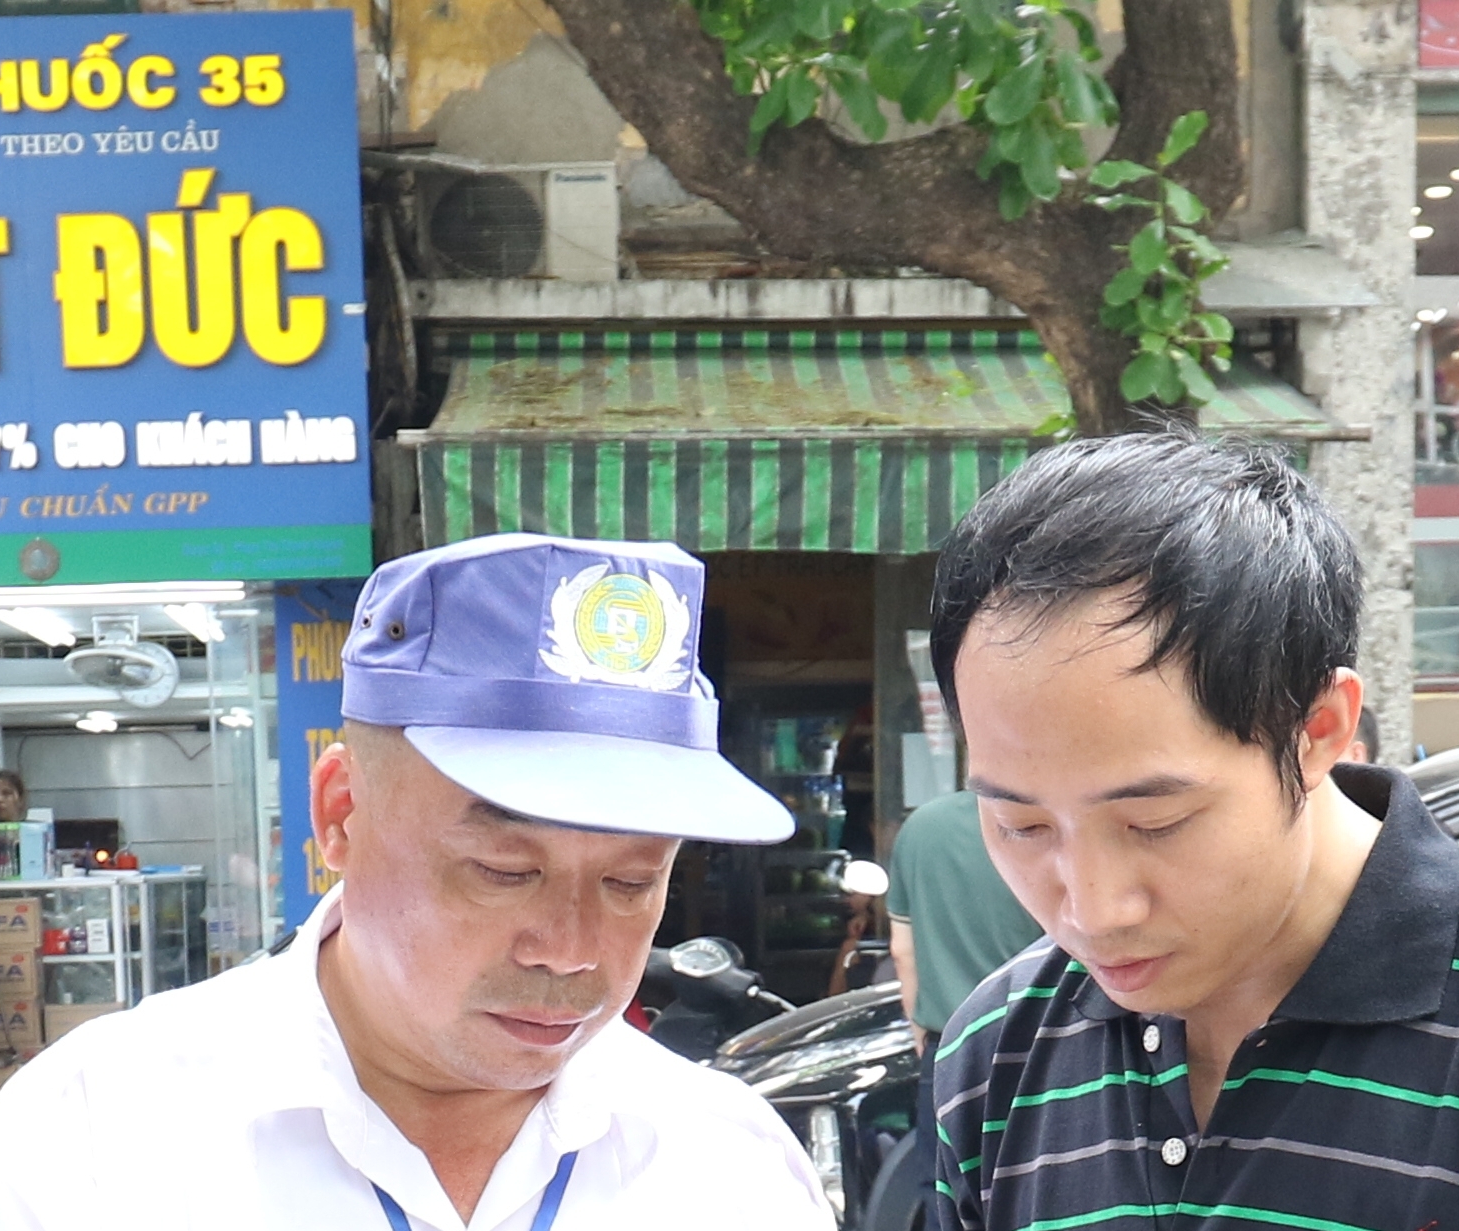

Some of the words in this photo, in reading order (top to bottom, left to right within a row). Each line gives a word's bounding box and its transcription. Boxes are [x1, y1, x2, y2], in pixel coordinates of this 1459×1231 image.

[198, 53, 286, 107] 35
[0, 132, 84, 158] THEO
[93, 125, 156, 156] YÊU
[53, 167, 327, 369] ĐỨC
[53, 420, 127, 470] CHO
[136, 410, 253, 468] KHÁCH
[259, 410, 358, 466] HÀNG
[143, 491, 210, 517] GPP
